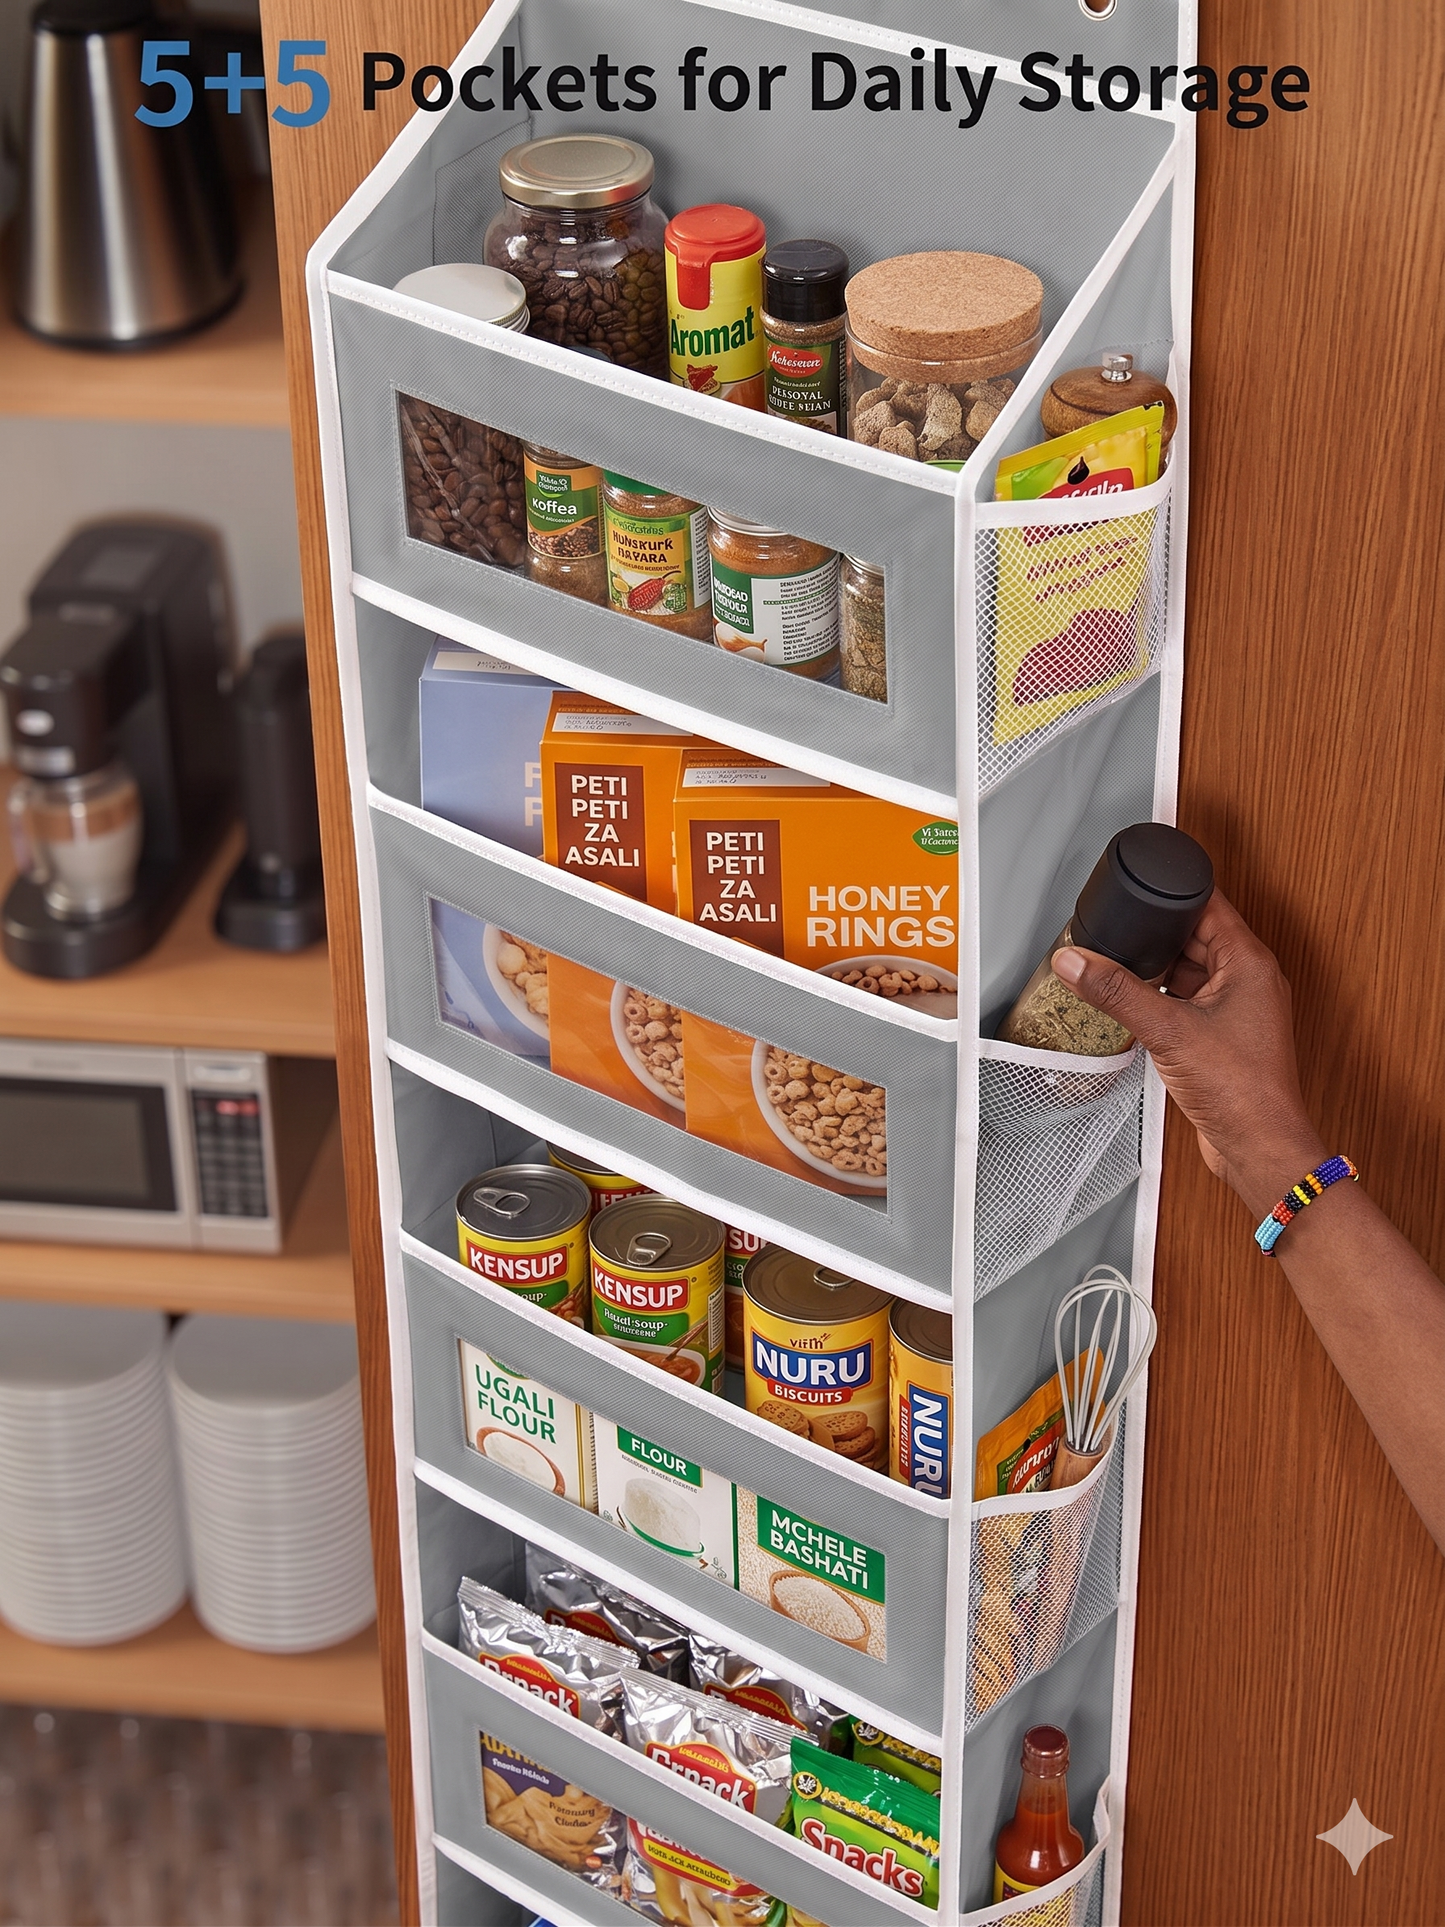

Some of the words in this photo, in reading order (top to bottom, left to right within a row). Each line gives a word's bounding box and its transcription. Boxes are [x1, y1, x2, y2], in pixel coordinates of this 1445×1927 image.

[670, 306, 755, 357] Aromat
[532, 498, 577, 515] Koffea
[571, 774, 627, 796] PETI
[572, 798, 628, 820] PETI
[584, 823, 620, 843] ZA
[706, 832, 764, 851] PETI
[565, 846, 640, 867] ASALI
[707, 855, 765, 875] PETI
[719, 879, 756, 899] ZA
[808, 885, 950, 912] HONEY
[699, 903, 777, 922] ASALI
[806, 916, 956, 947] RINGS
[470, 1247, 563, 1280] KENSUP
[593, 1266, 684, 1308] KENSUP
[756, 1341, 865, 1386] NURU
[475, 1364, 555, 1420] UGALI
[775, 1384, 843, 1403] BISCUITS
[477, 1390, 557, 1444] FLOUR
[631, 1437, 687, 1476] FLOUR
[771, 1509, 867, 1568] MCHELE
[770, 1528, 868, 1590] BASHATI
[802, 1817, 924, 1897] Snacks
